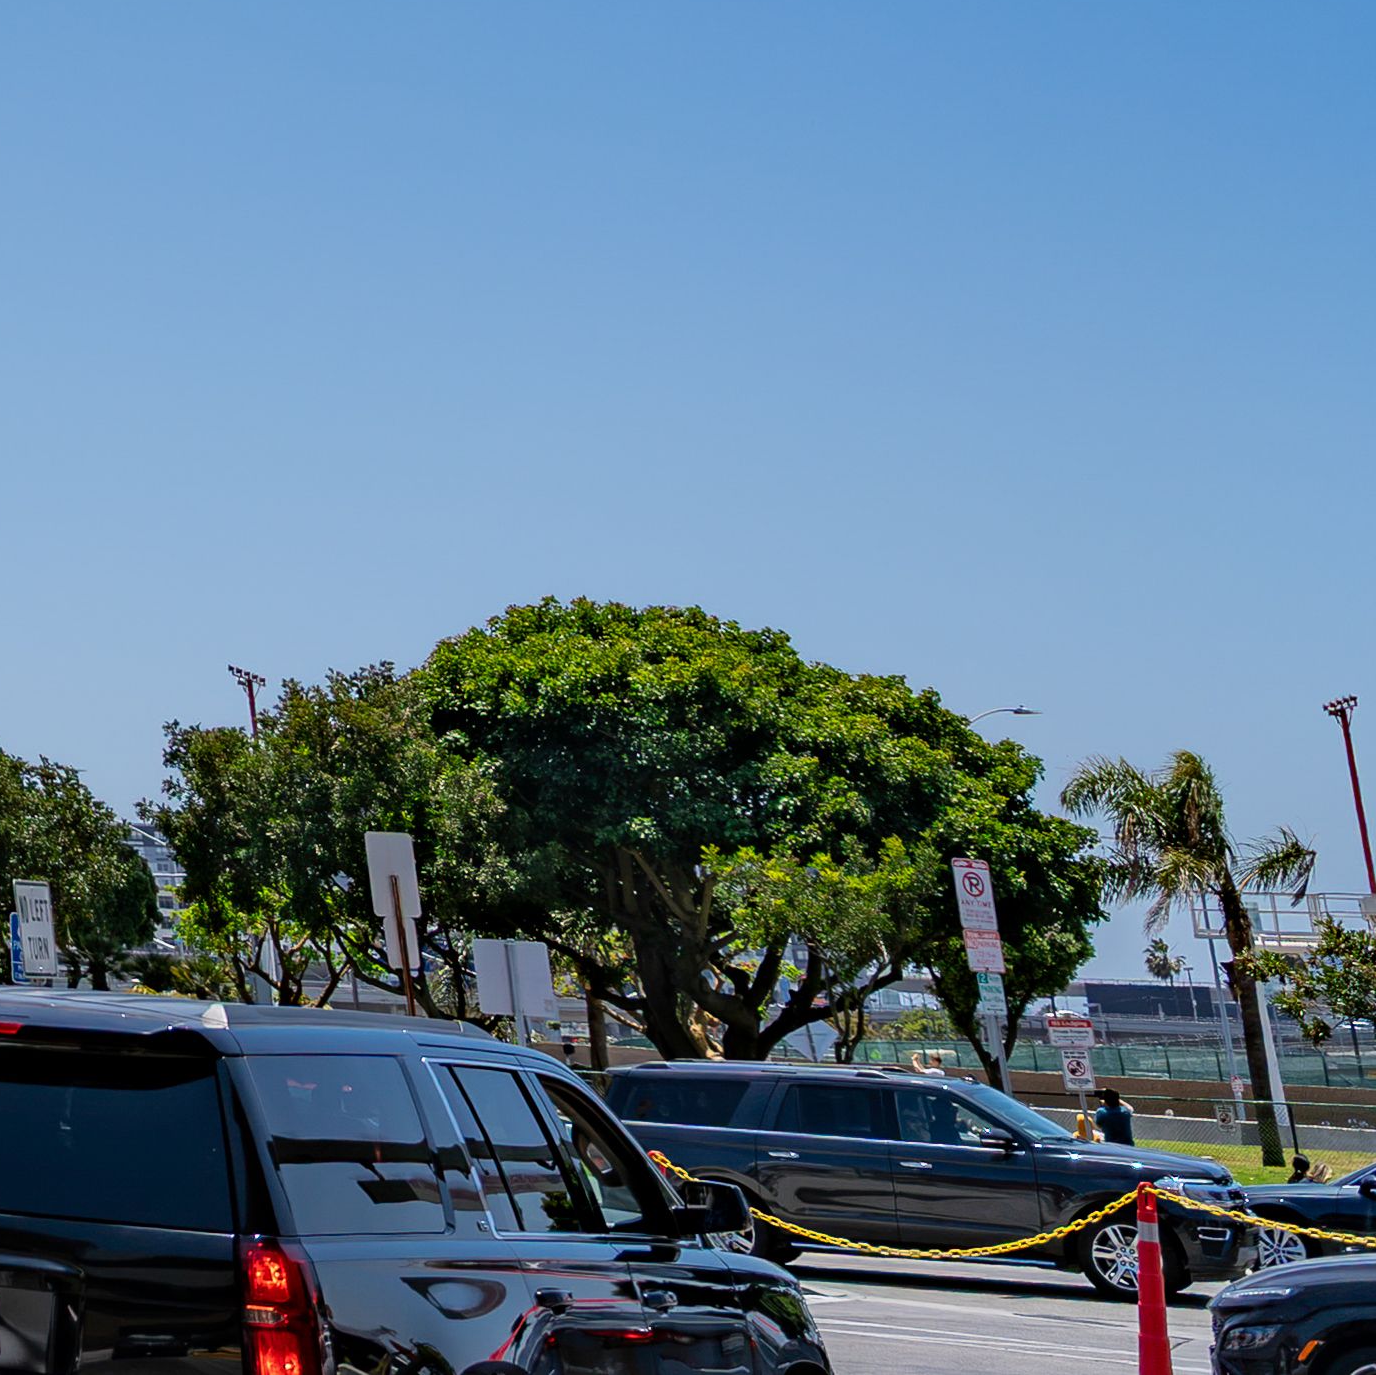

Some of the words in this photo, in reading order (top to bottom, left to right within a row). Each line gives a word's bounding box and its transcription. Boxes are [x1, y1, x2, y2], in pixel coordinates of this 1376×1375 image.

[18, 895, 29, 923] NO
[29, 897, 49, 923] LEFT
[27, 936, 50, 960] TURN
[980, 973, 987, 983] 2
